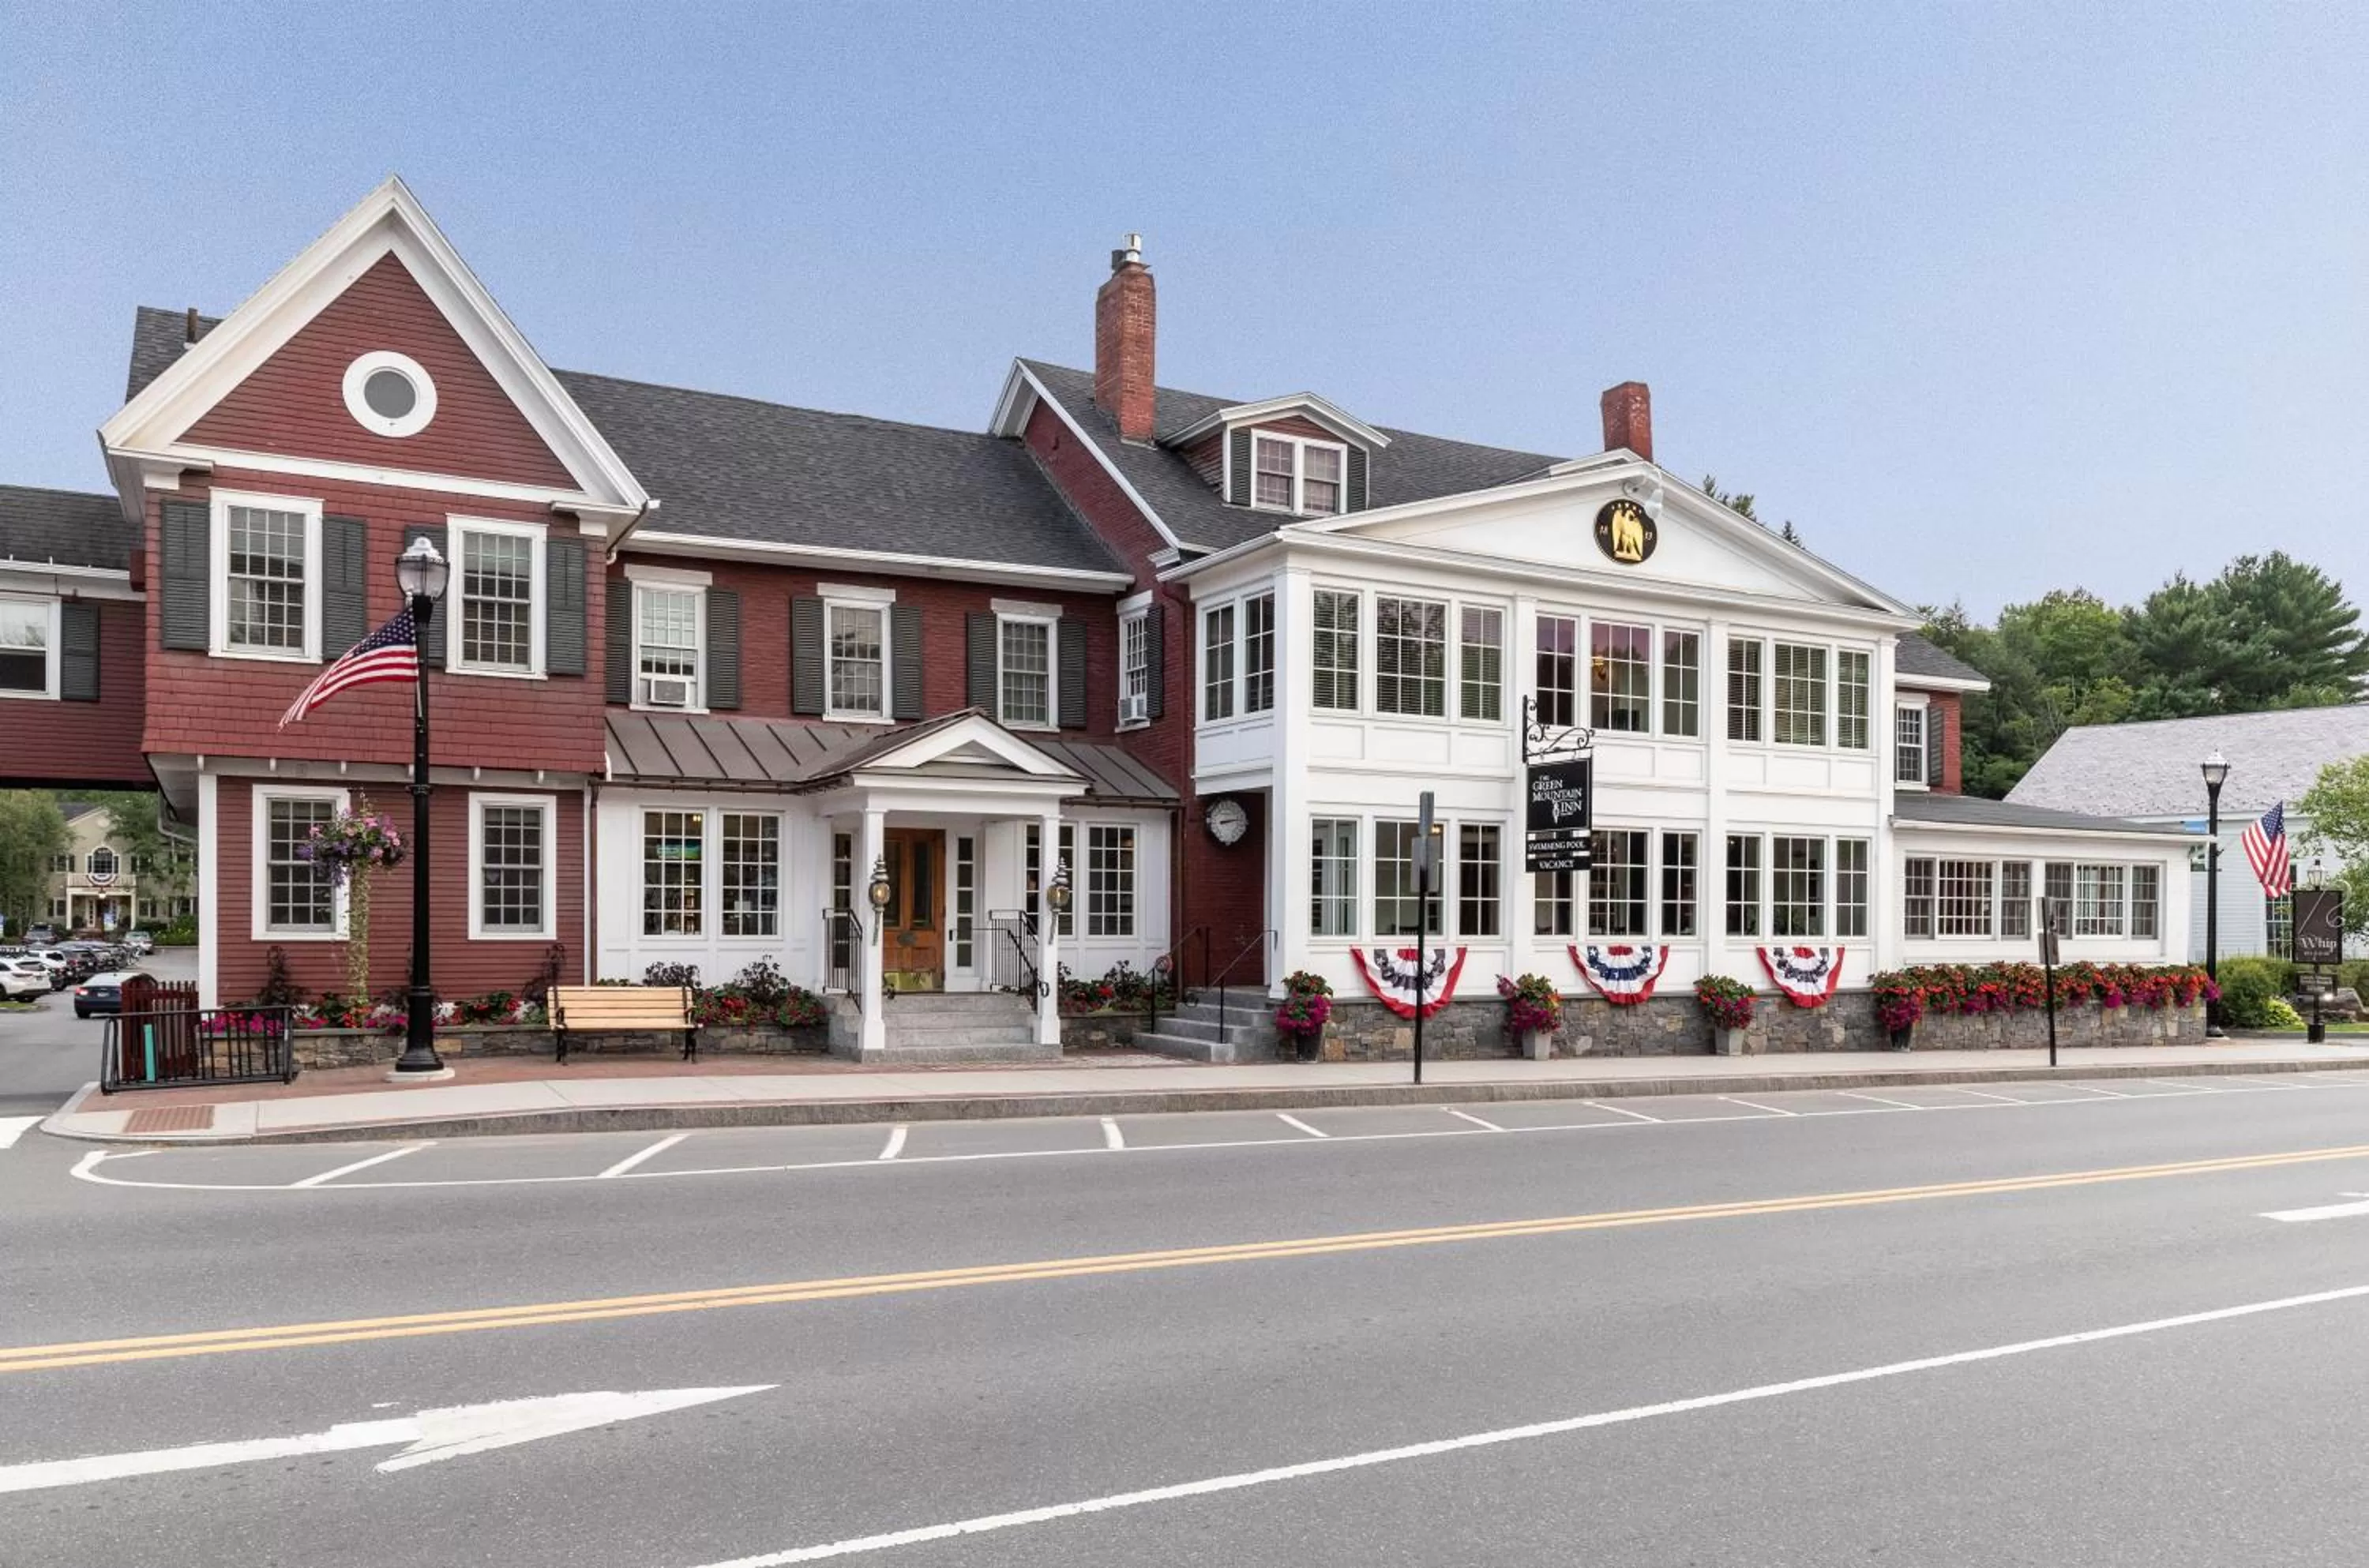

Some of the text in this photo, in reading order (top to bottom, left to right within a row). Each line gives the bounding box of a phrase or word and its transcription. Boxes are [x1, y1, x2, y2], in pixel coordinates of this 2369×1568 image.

[1533, 780, 1562, 791] GREEN
[1533, 788, 1582, 801] MOUNTAIN
[1561, 801, 1582, 812] INN
[1529, 842, 1565, 850] SWIMMING
[1539, 860, 1574, 868] VACANCY
[2300, 937, 2337, 953] Whip
